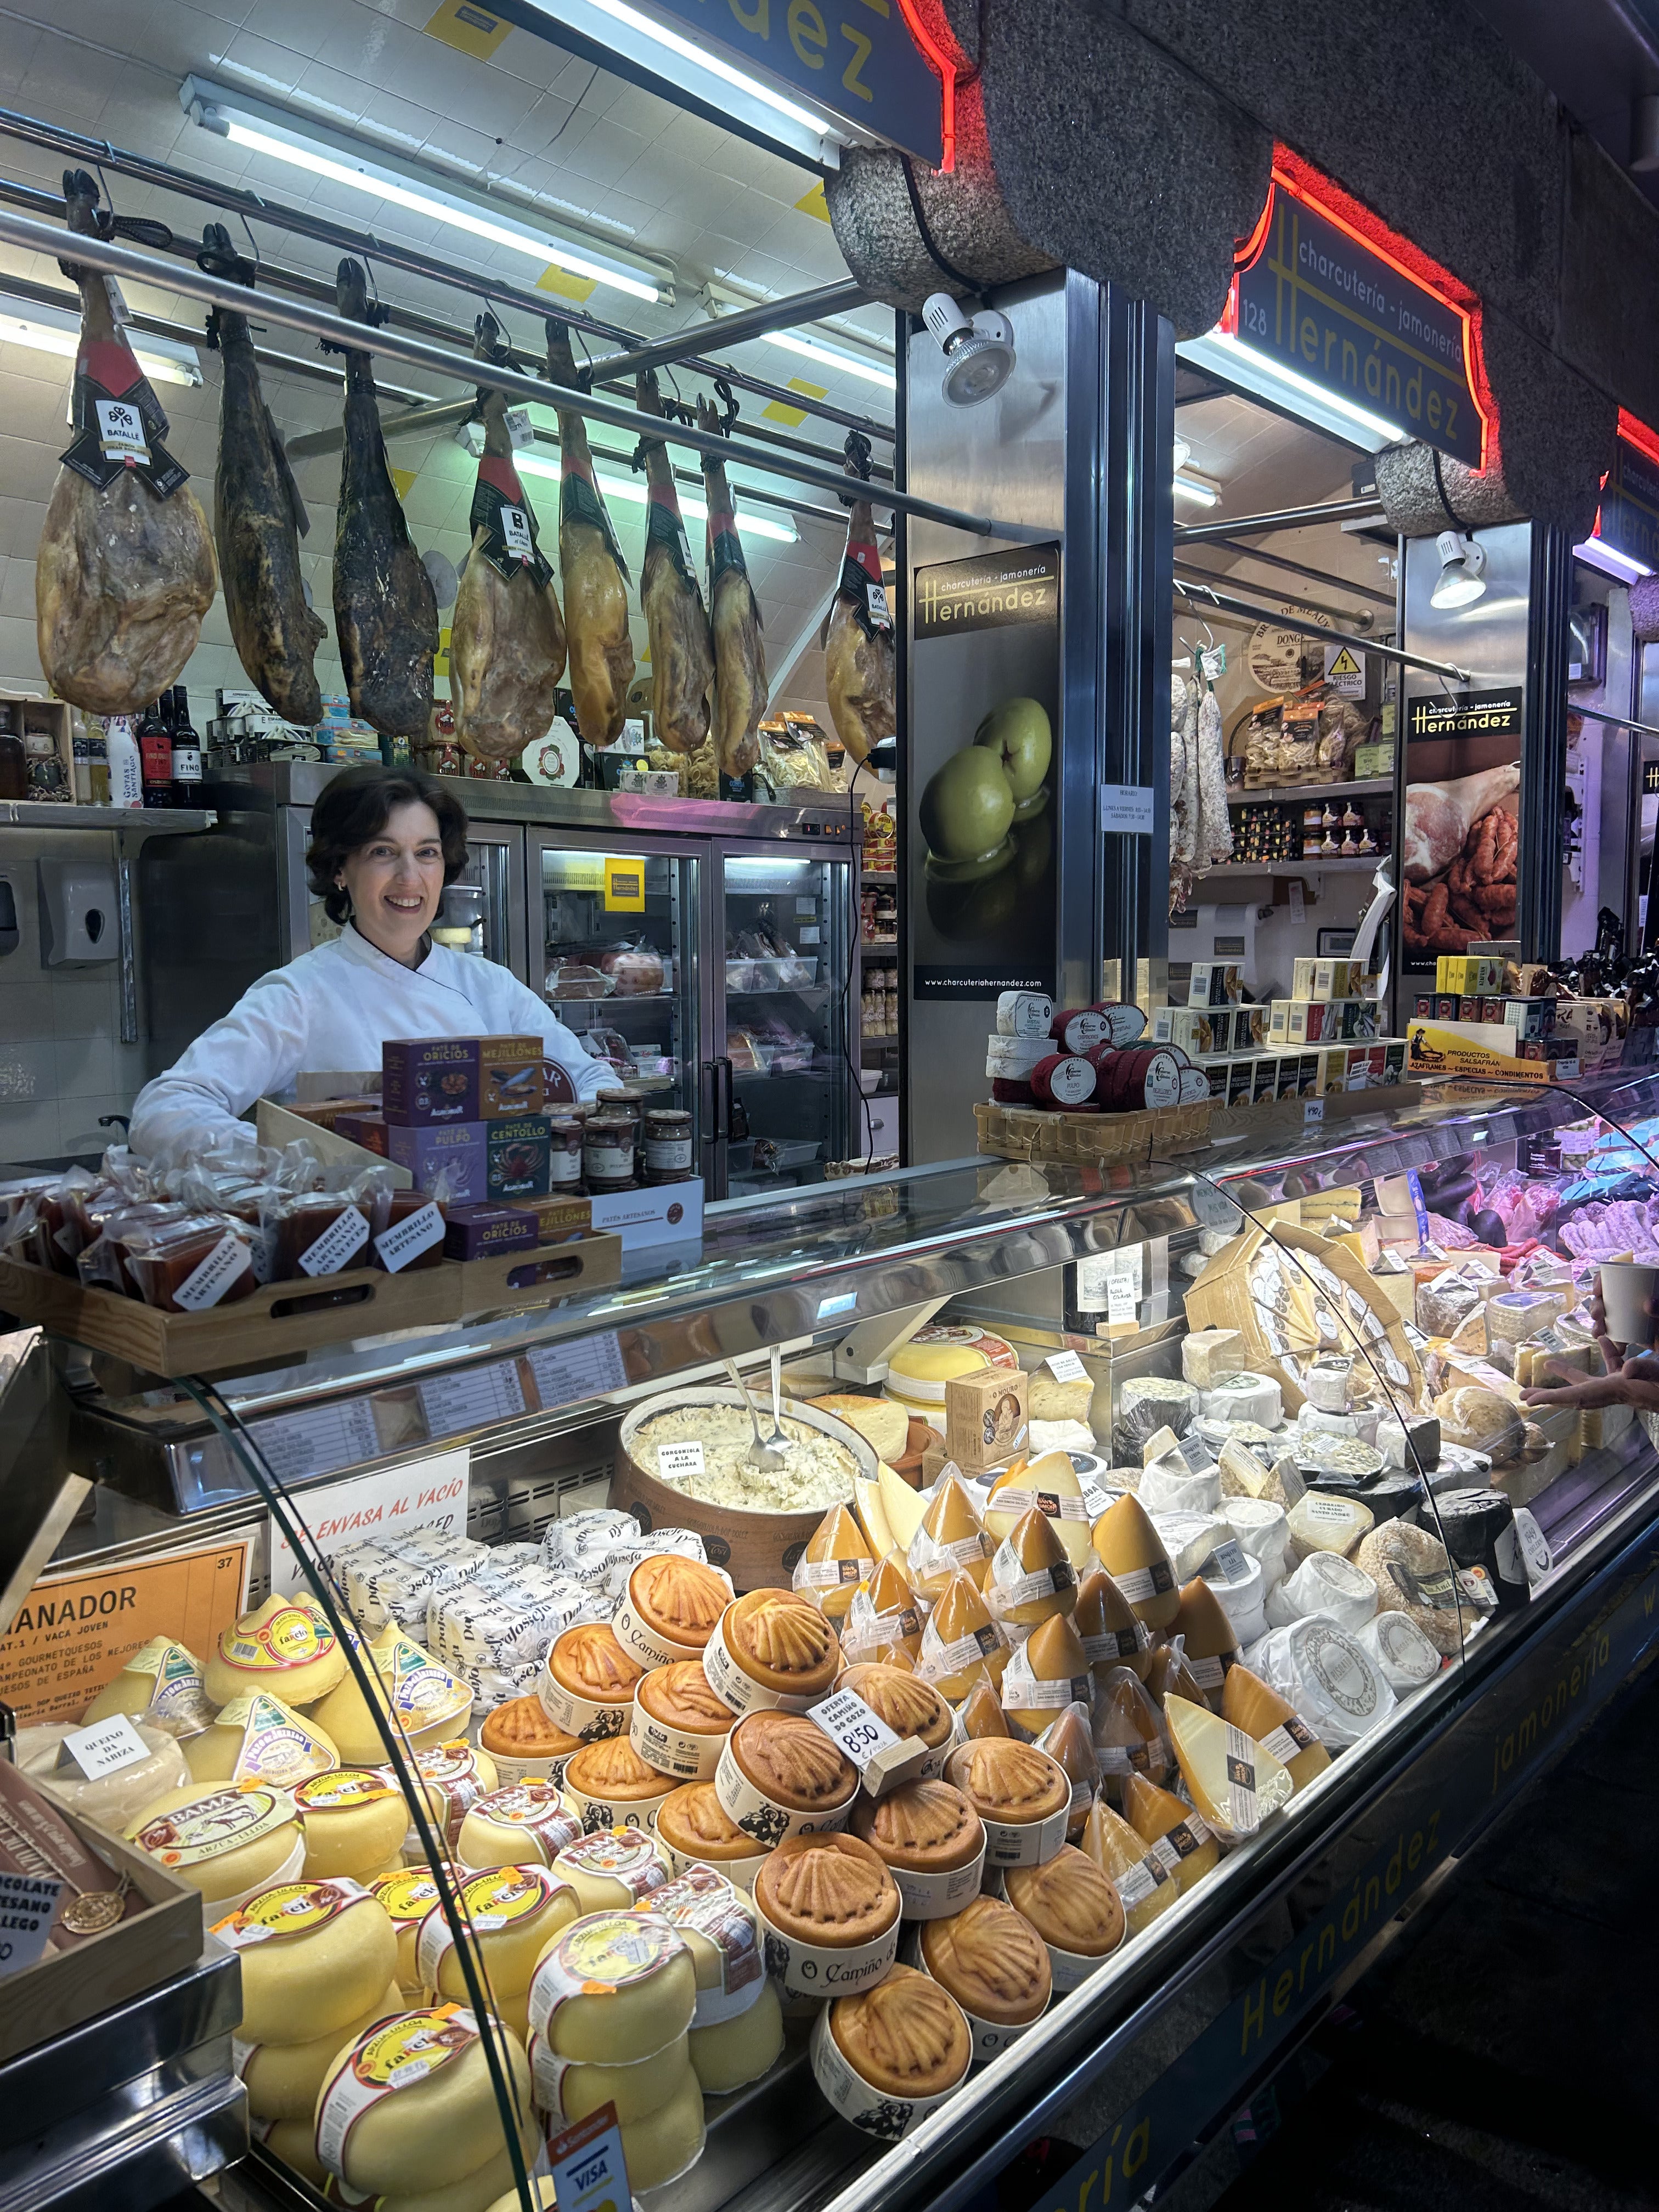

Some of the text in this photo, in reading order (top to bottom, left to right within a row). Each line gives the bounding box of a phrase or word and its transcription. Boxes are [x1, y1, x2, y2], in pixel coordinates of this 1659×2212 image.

[1298, 239, 1385, 314] charcutería
[1397, 301, 1463, 363] jamonería
[1243, 300, 1267, 337] 128
[1268, 203, 1459, 439] Hernández
[941, 575, 991, 592] charcutería
[1000, 564, 1046, 583] jamonería
[919, 579, 1047, 624] Hernández
[1474, 700, 1511, 711] jamonería
[1412, 706, 1511, 734] Hernández
[924, 979, 1042, 988] www.charcuteriahernandez.com
[422, 1049, 469, 1062] ORICIOS
[1447, 1049, 1491, 1059] PRODUCTOS
[1409, 1062, 1544, 1080] AZAFRANES ESPECIAS CONDIMENTOS
[435, 1133, 471, 1145] PULPO
[491, 1126, 546, 1140] CENTOLLO
[379, 1208, 436, 1250] MEMBRILLO
[482, 1224, 528, 1241] ORICIOS
[539, 1210, 591, 1227] EJILLONES
[303, 1211, 354, 1265] MEMBRILLO
[316, 1221, 357, 1265] ARTESANO
[387, 1222, 435, 1257] ARTESANO
[998, 1384, 1018, 1398] MOURO
[661, 1447, 700, 1456] GORGONZOLA
[315, 1504, 384, 1541] ENVASA
[387, 1496, 409, 1519] AL
[416, 1477, 464, 1510] VACÍO
[217, 1556, 233, 1569] 37
[2, 1586, 137, 1636] ANADOR
[0, 1639, 25, 1653] AT.1
[45, 1630, 71, 1643] VACA
[77, 1620, 108, 1635] JOVEN
[620, 1614, 675, 1666] O Camiño
[0, 1663, 57, 1680] AMPEONATO
[63, 1658, 76, 1668] DE
[83, 1651, 102, 1664] LOS
[19, 1639, 103, 1668] GOURMETQUESOS
[0, 1664, 94, 1696] UESOS DE ESPAÑA
[821, 1695, 850, 1716] OFERTA
[828, 1701, 857, 1723] CAMIÑO
[834, 1708, 866, 1731] DO GOZO
[1492, 1632, 1611, 1795] jamonería
[84, 1730, 124, 1752] QUEIXO
[103, 1742, 119, 1756] DA
[95, 1746, 136, 1768] NABIZA
[168, 1794, 238, 1824] BAMA
[0, 1875, 60, 1897] COLATE
[0, 1894, 51, 1914] ESANO
[0, 1918, 40, 1932] LEGO
[1240, 1809, 1443, 2057] Hernández
[801, 1956, 882, 1989] O Camiño
[574, 2161, 609, 2191] VISA
